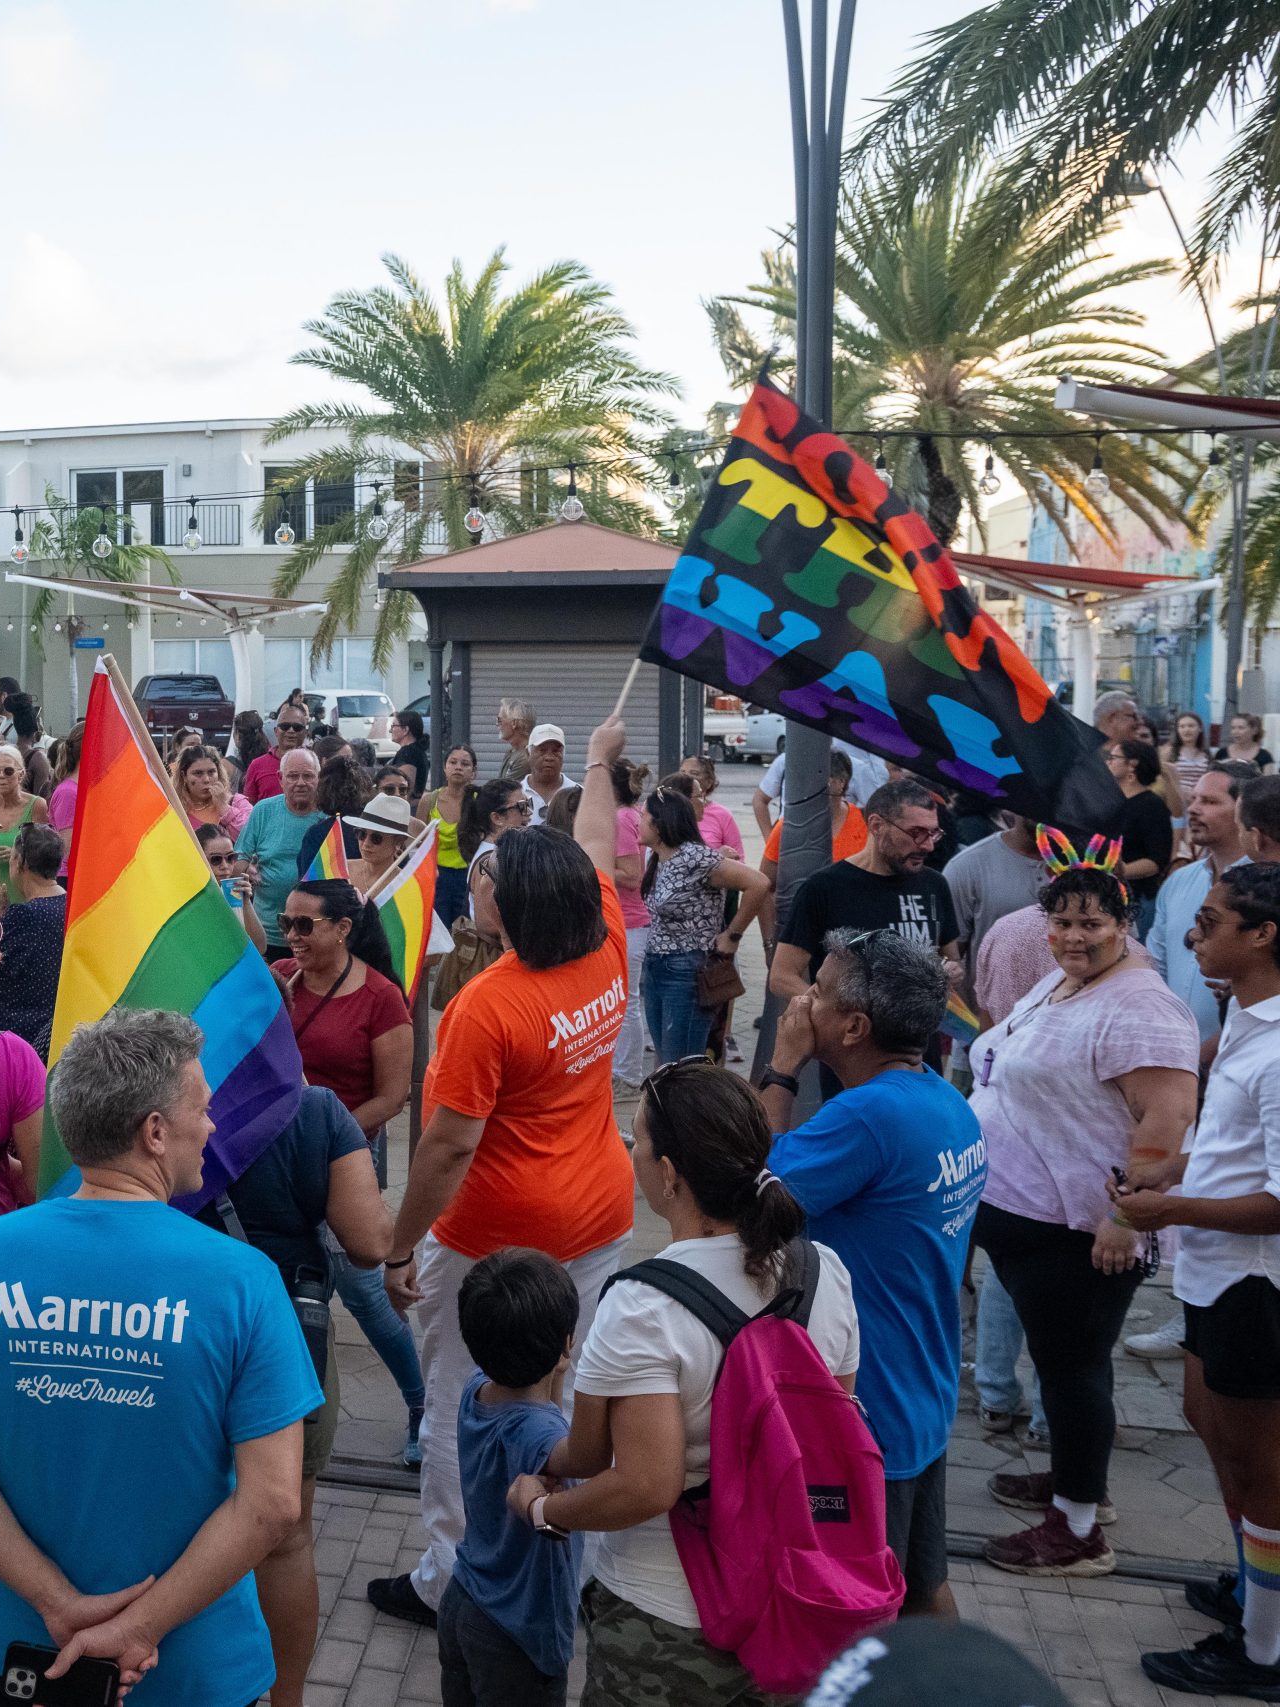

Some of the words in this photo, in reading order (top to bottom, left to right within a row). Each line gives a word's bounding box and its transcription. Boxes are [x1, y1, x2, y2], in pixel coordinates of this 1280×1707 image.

[898, 894, 929, 921] HE
[547, 974, 626, 1050] Marriott
[564, 1010, 624, 1054] INTERNATIONAL
[926, 1128, 988, 1193] Marrio
[7, 1339, 165, 1367] INTERNATIONAL
[14, 1373, 157, 1409] #LoveTravels
[808, 1495, 844, 1512] SPORT
